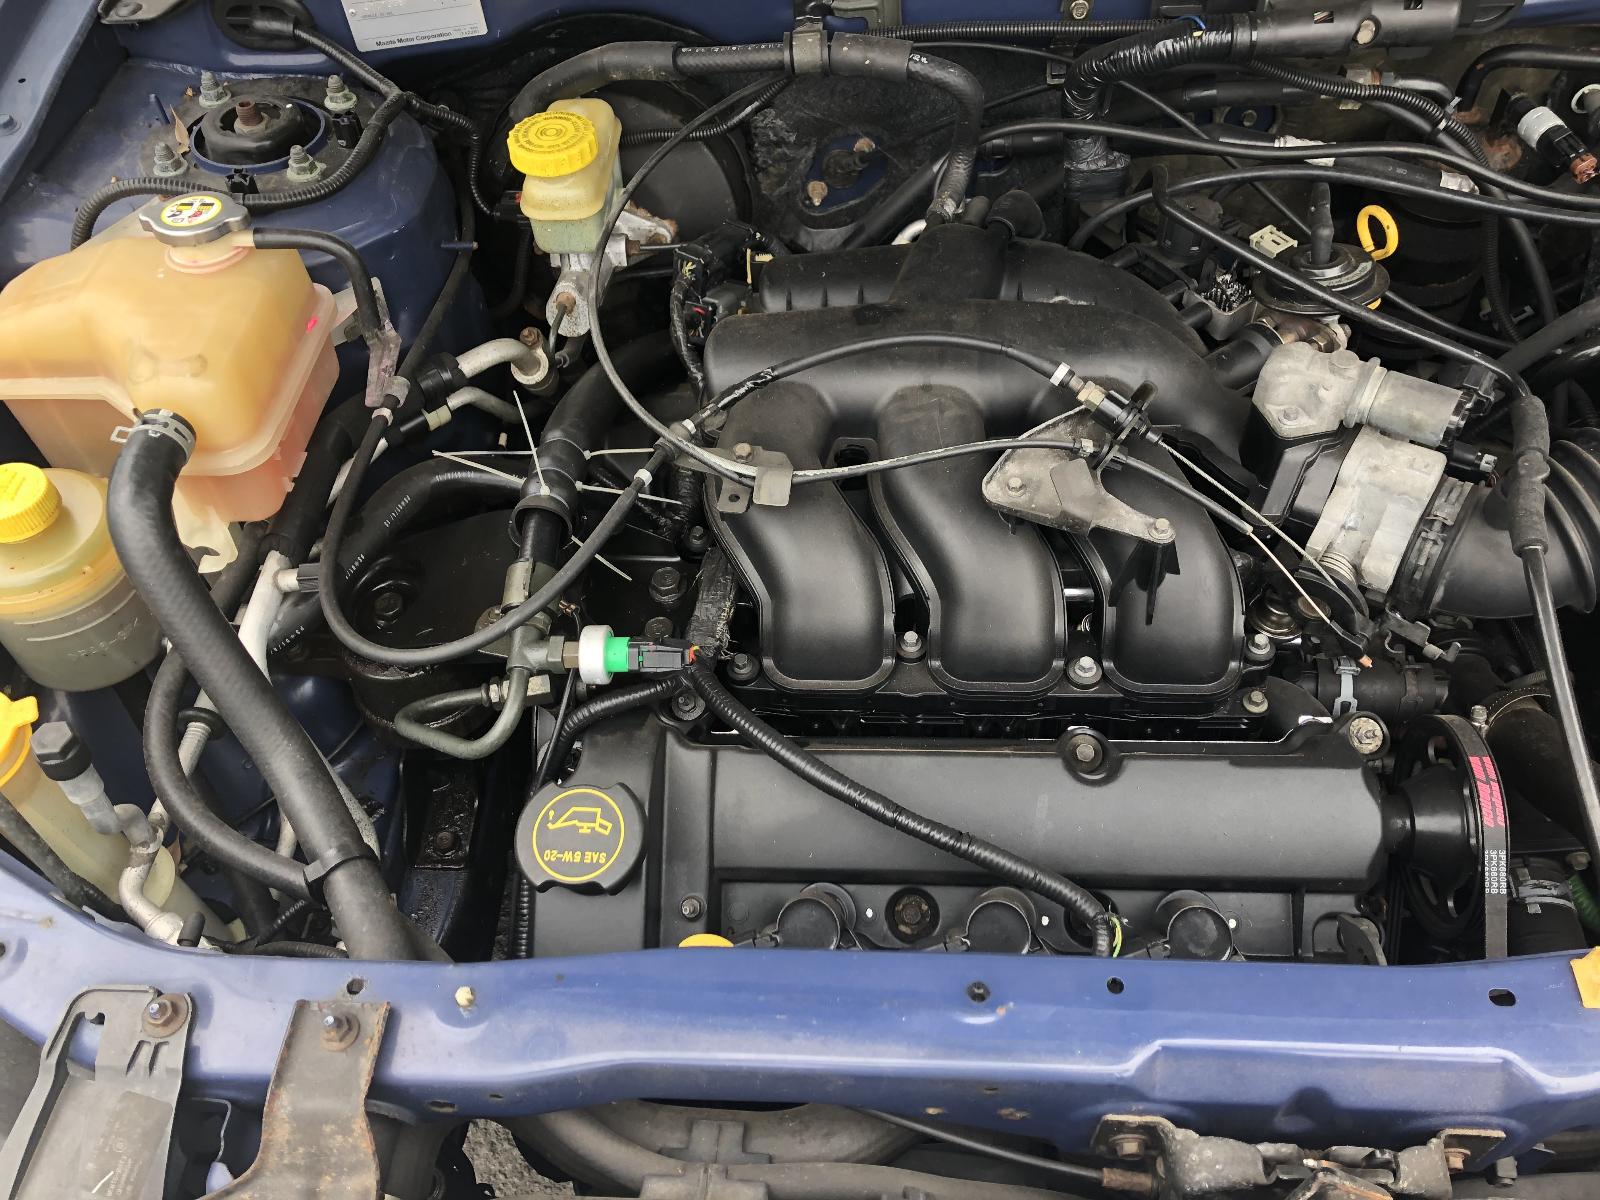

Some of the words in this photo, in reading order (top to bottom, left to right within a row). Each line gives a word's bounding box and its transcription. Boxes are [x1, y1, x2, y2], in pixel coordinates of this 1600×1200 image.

[375, 39, 397, 47] Mazda
[415, 31, 452, 41] Corporation
[543, 850, 582, 863] 5W-20
[584, 851, 607, 864] SAE
[1490, 849, 1498, 894] 3PK680RB
